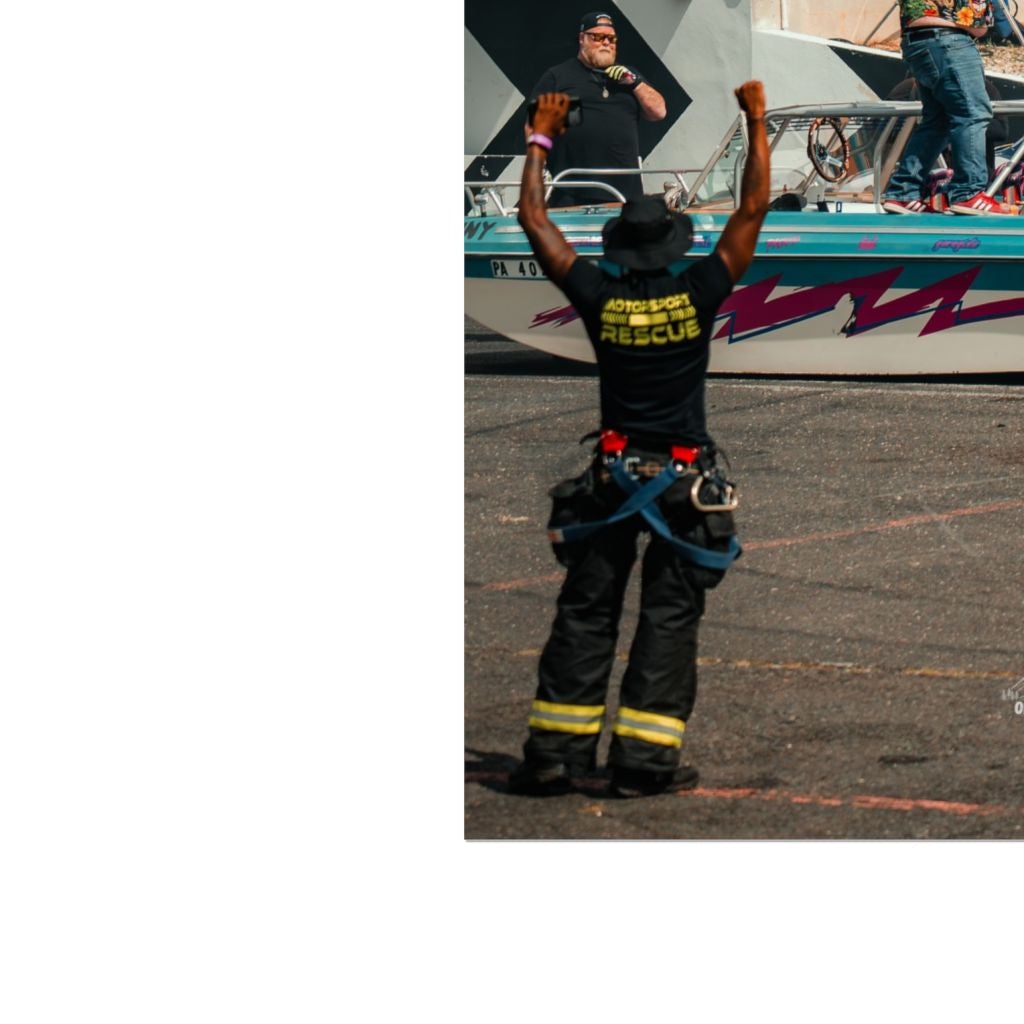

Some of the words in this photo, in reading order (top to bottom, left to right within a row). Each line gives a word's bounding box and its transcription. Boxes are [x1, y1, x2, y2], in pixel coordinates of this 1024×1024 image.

[492, 261, 508, 276] PA
[603, 292, 691, 313] MOTORSPORT
[600, 318, 701, 346] RESCUE
